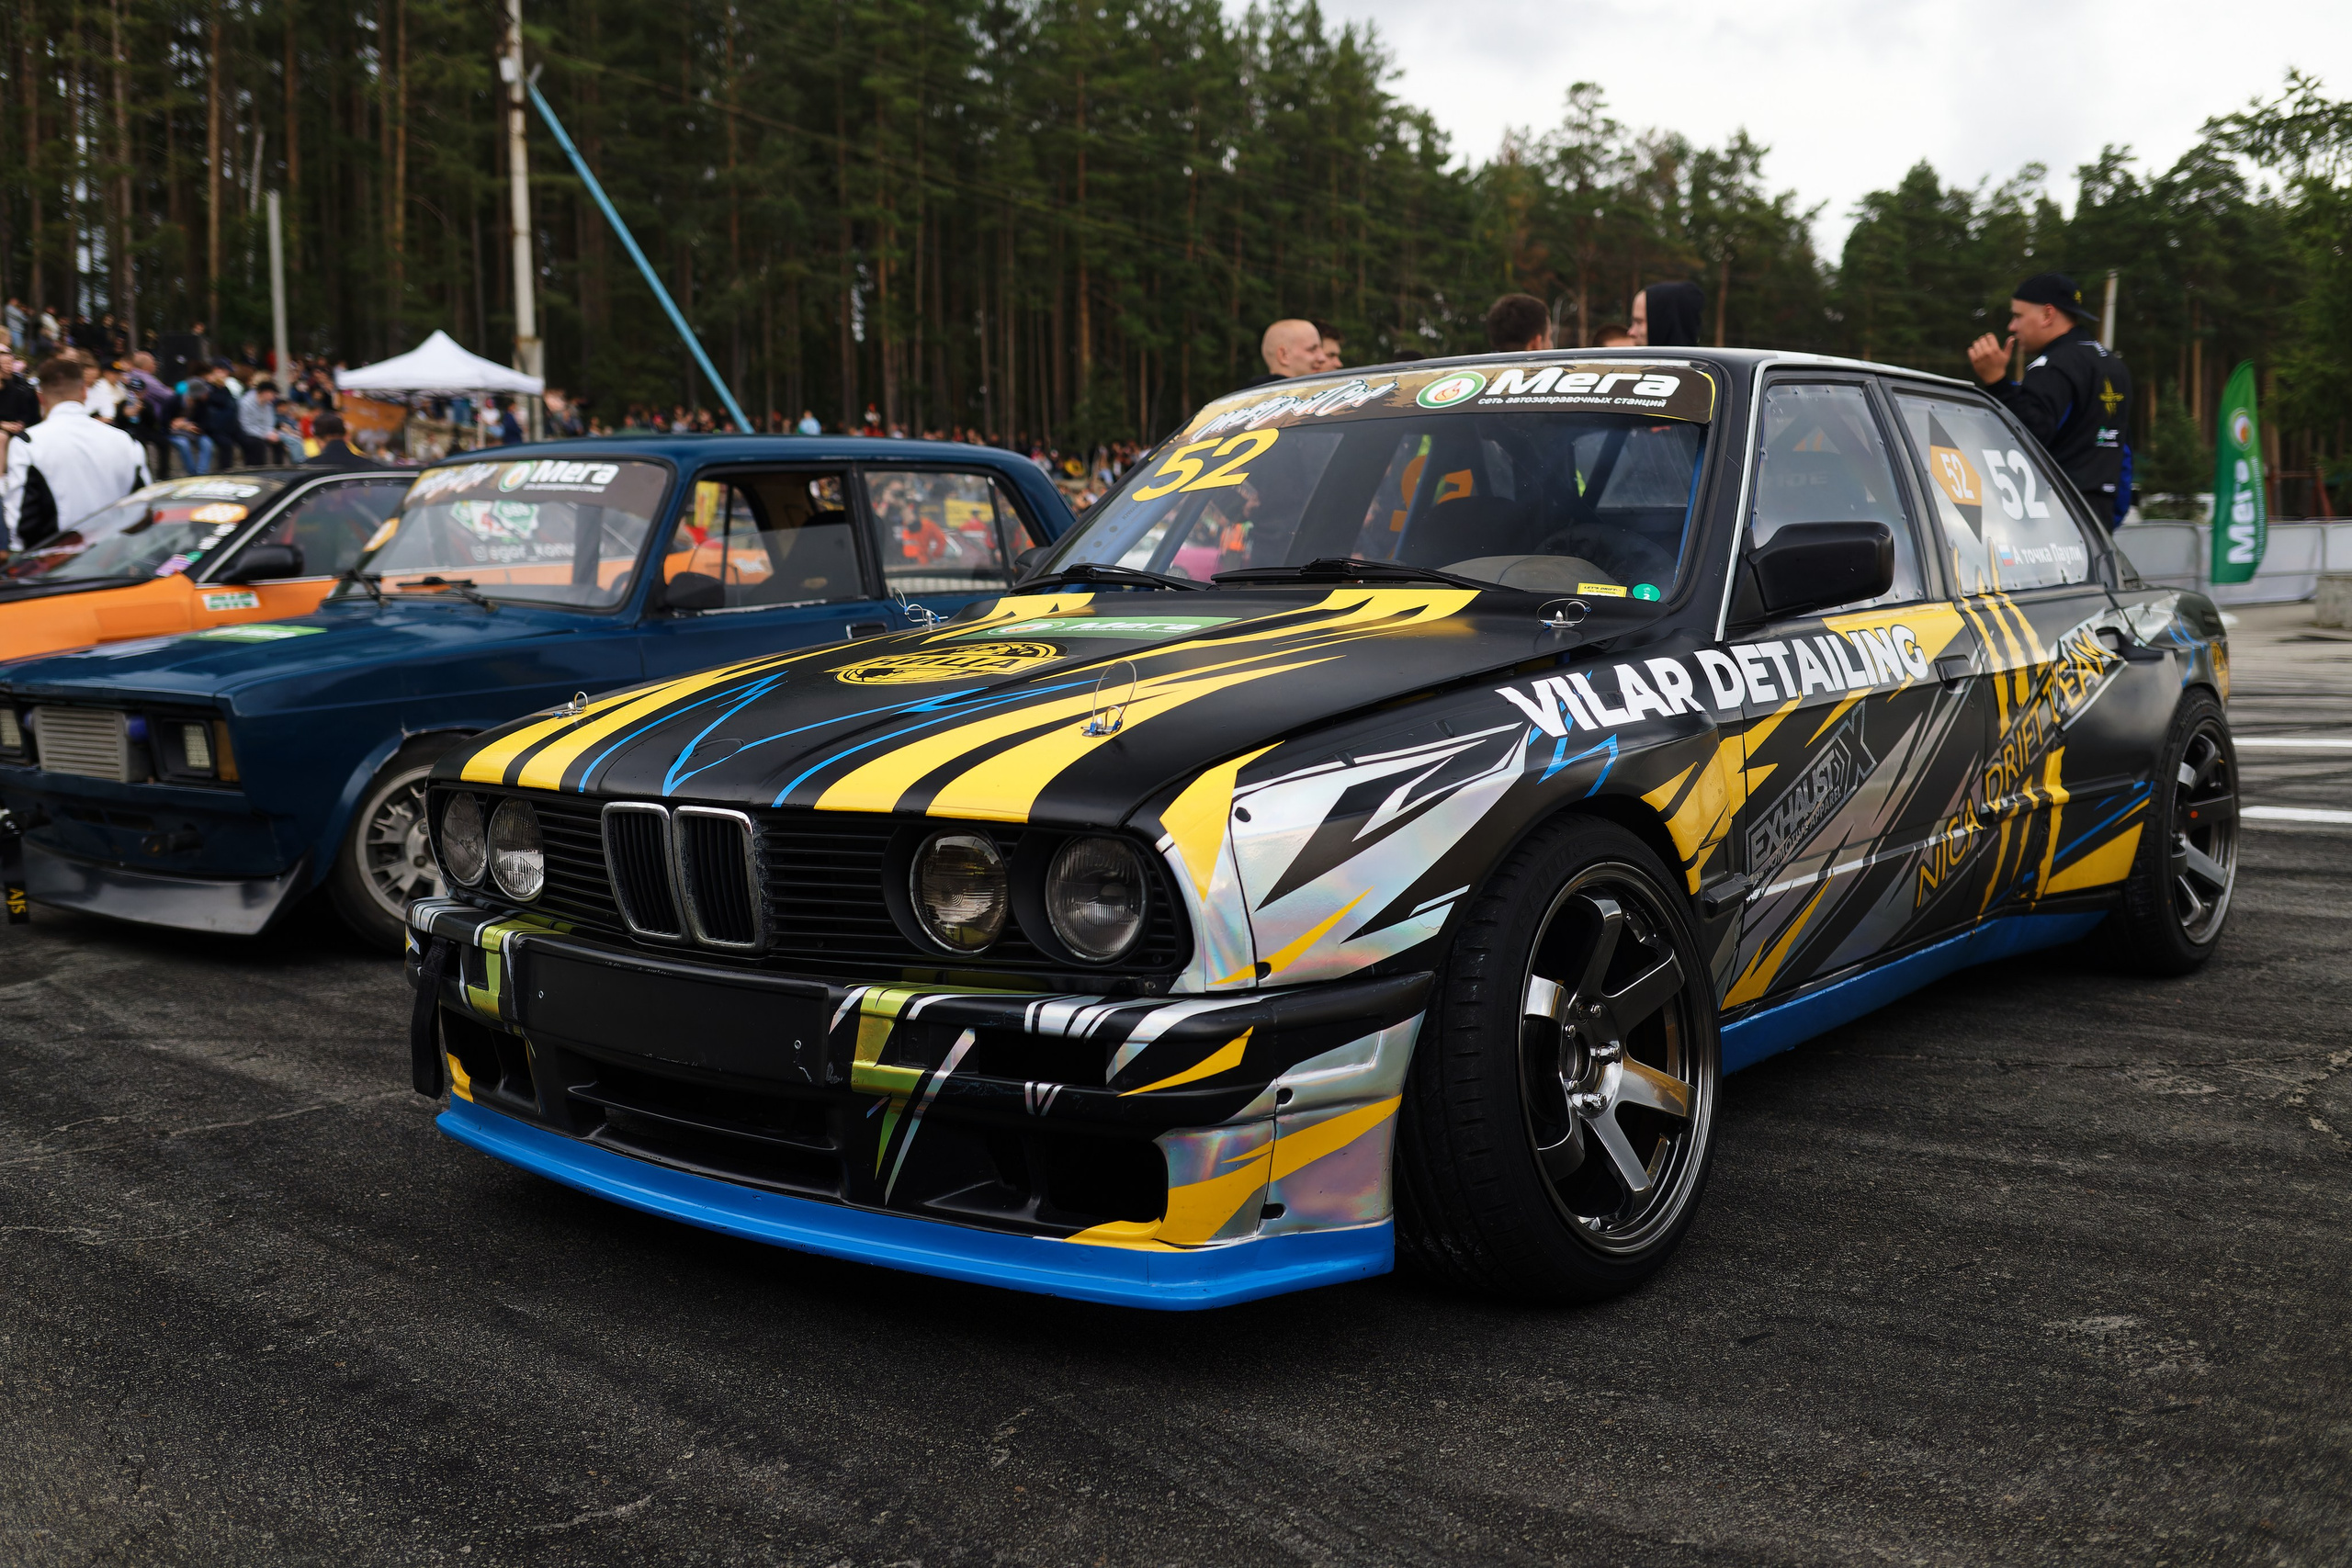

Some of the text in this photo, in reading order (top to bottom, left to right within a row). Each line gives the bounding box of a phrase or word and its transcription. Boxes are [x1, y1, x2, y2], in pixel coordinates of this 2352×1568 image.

[1478, 396, 1667, 407] сеть автозаправочных станций
[1486, 367, 1680, 397] Мега
[529, 459, 619, 485] Мега
[1132, 428, 1279, 502] 52
[1939, 453, 1974, 500] 52
[1982, 449, 2051, 520] 52
[2024, 548, 2052, 564] точка
[2050, 543, 2083, 566] Паули
[1495, 625, 1929, 738] VILAR DETAILING
[1917, 632, 2118, 908] NICA DRIFT TEAM
[1752, 748, 1837, 874] EXHAUST
[1809, 785, 1843, 829] APPAREL
